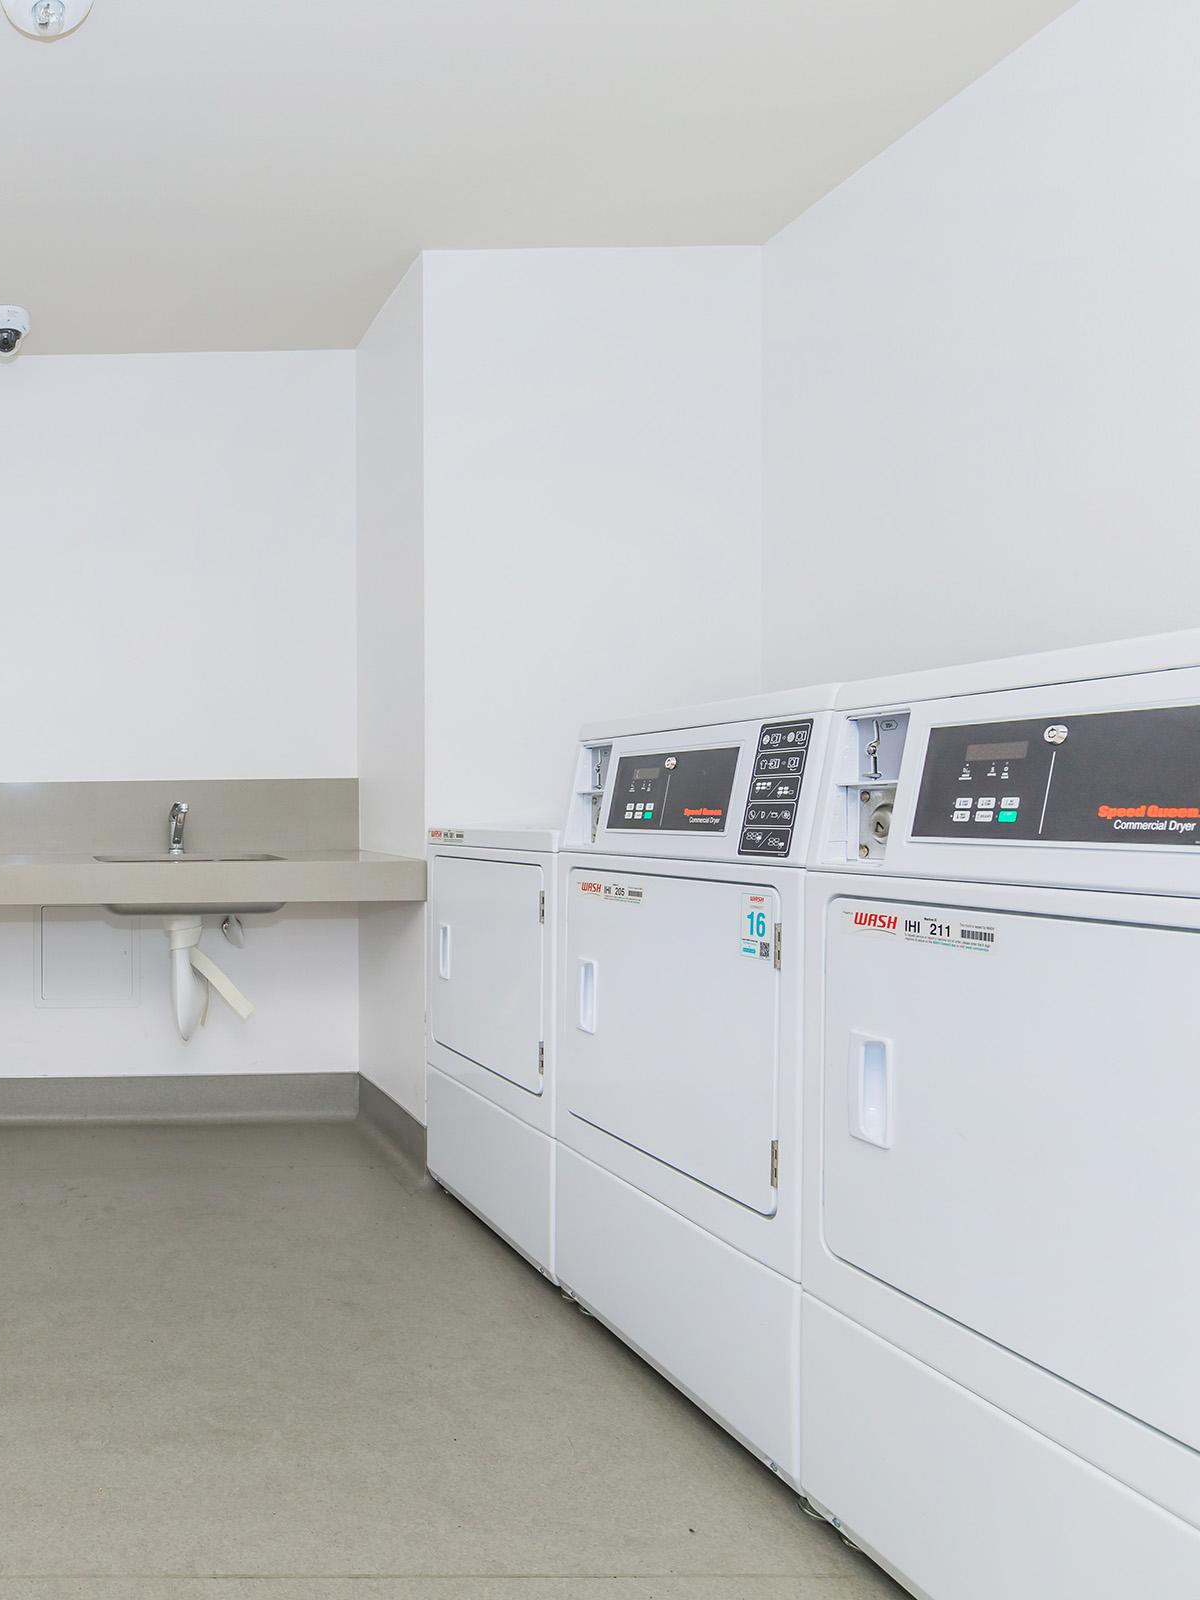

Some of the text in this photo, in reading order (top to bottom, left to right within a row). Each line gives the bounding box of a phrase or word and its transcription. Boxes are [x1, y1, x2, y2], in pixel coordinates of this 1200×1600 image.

[683, 807, 703, 817] Speed
[1097, 804, 1200, 820] Speed Queen
[688, 816, 721, 825] Commercial Dryer
[1113, 819, 1197, 833] Commercial Dryer
[581, 882, 602, 893] WASH
[614, 887, 625, 897] 205
[746, 911, 766, 938] 16
[853, 911, 898, 930] WASH
[904, 920, 921, 934] IHI
[929, 923, 951, 938] 211
